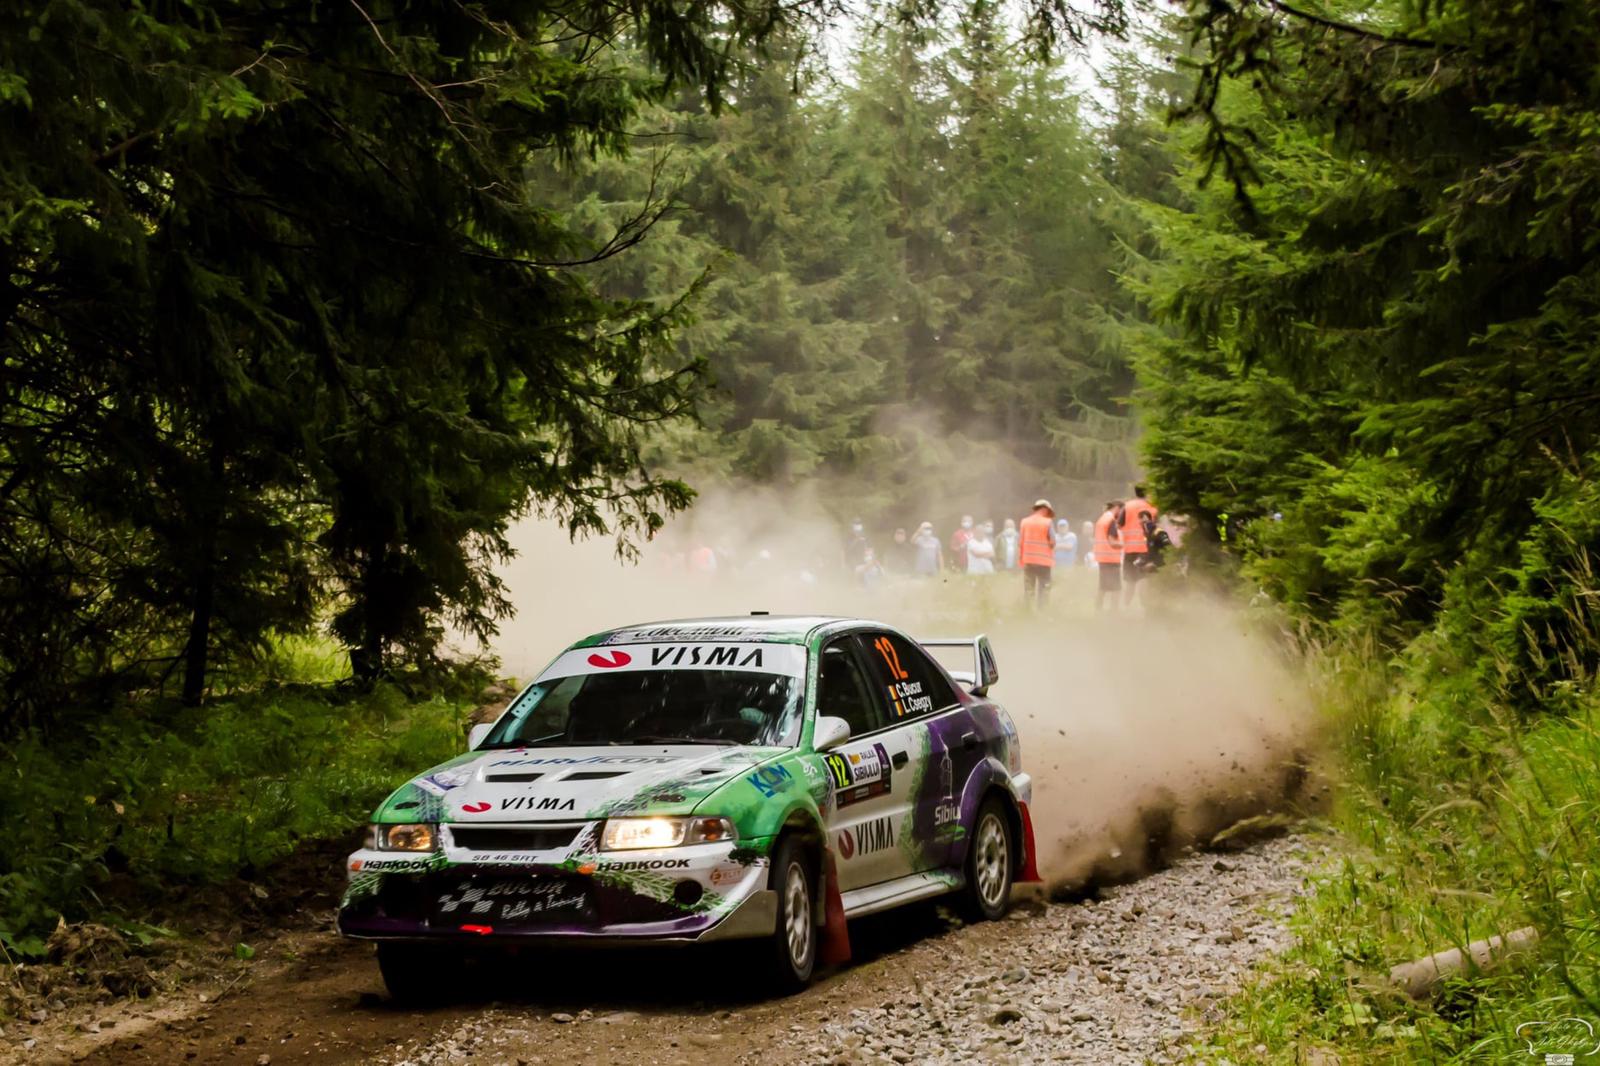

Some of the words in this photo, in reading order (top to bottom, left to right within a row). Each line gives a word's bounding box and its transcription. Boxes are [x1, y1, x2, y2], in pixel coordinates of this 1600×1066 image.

[651, 646, 763, 668] VISMA
[875, 636, 909, 680] 12
[829, 755, 850, 788] 12
[501, 796, 576, 811] VISMA
[855, 816, 894, 857] VISMA
